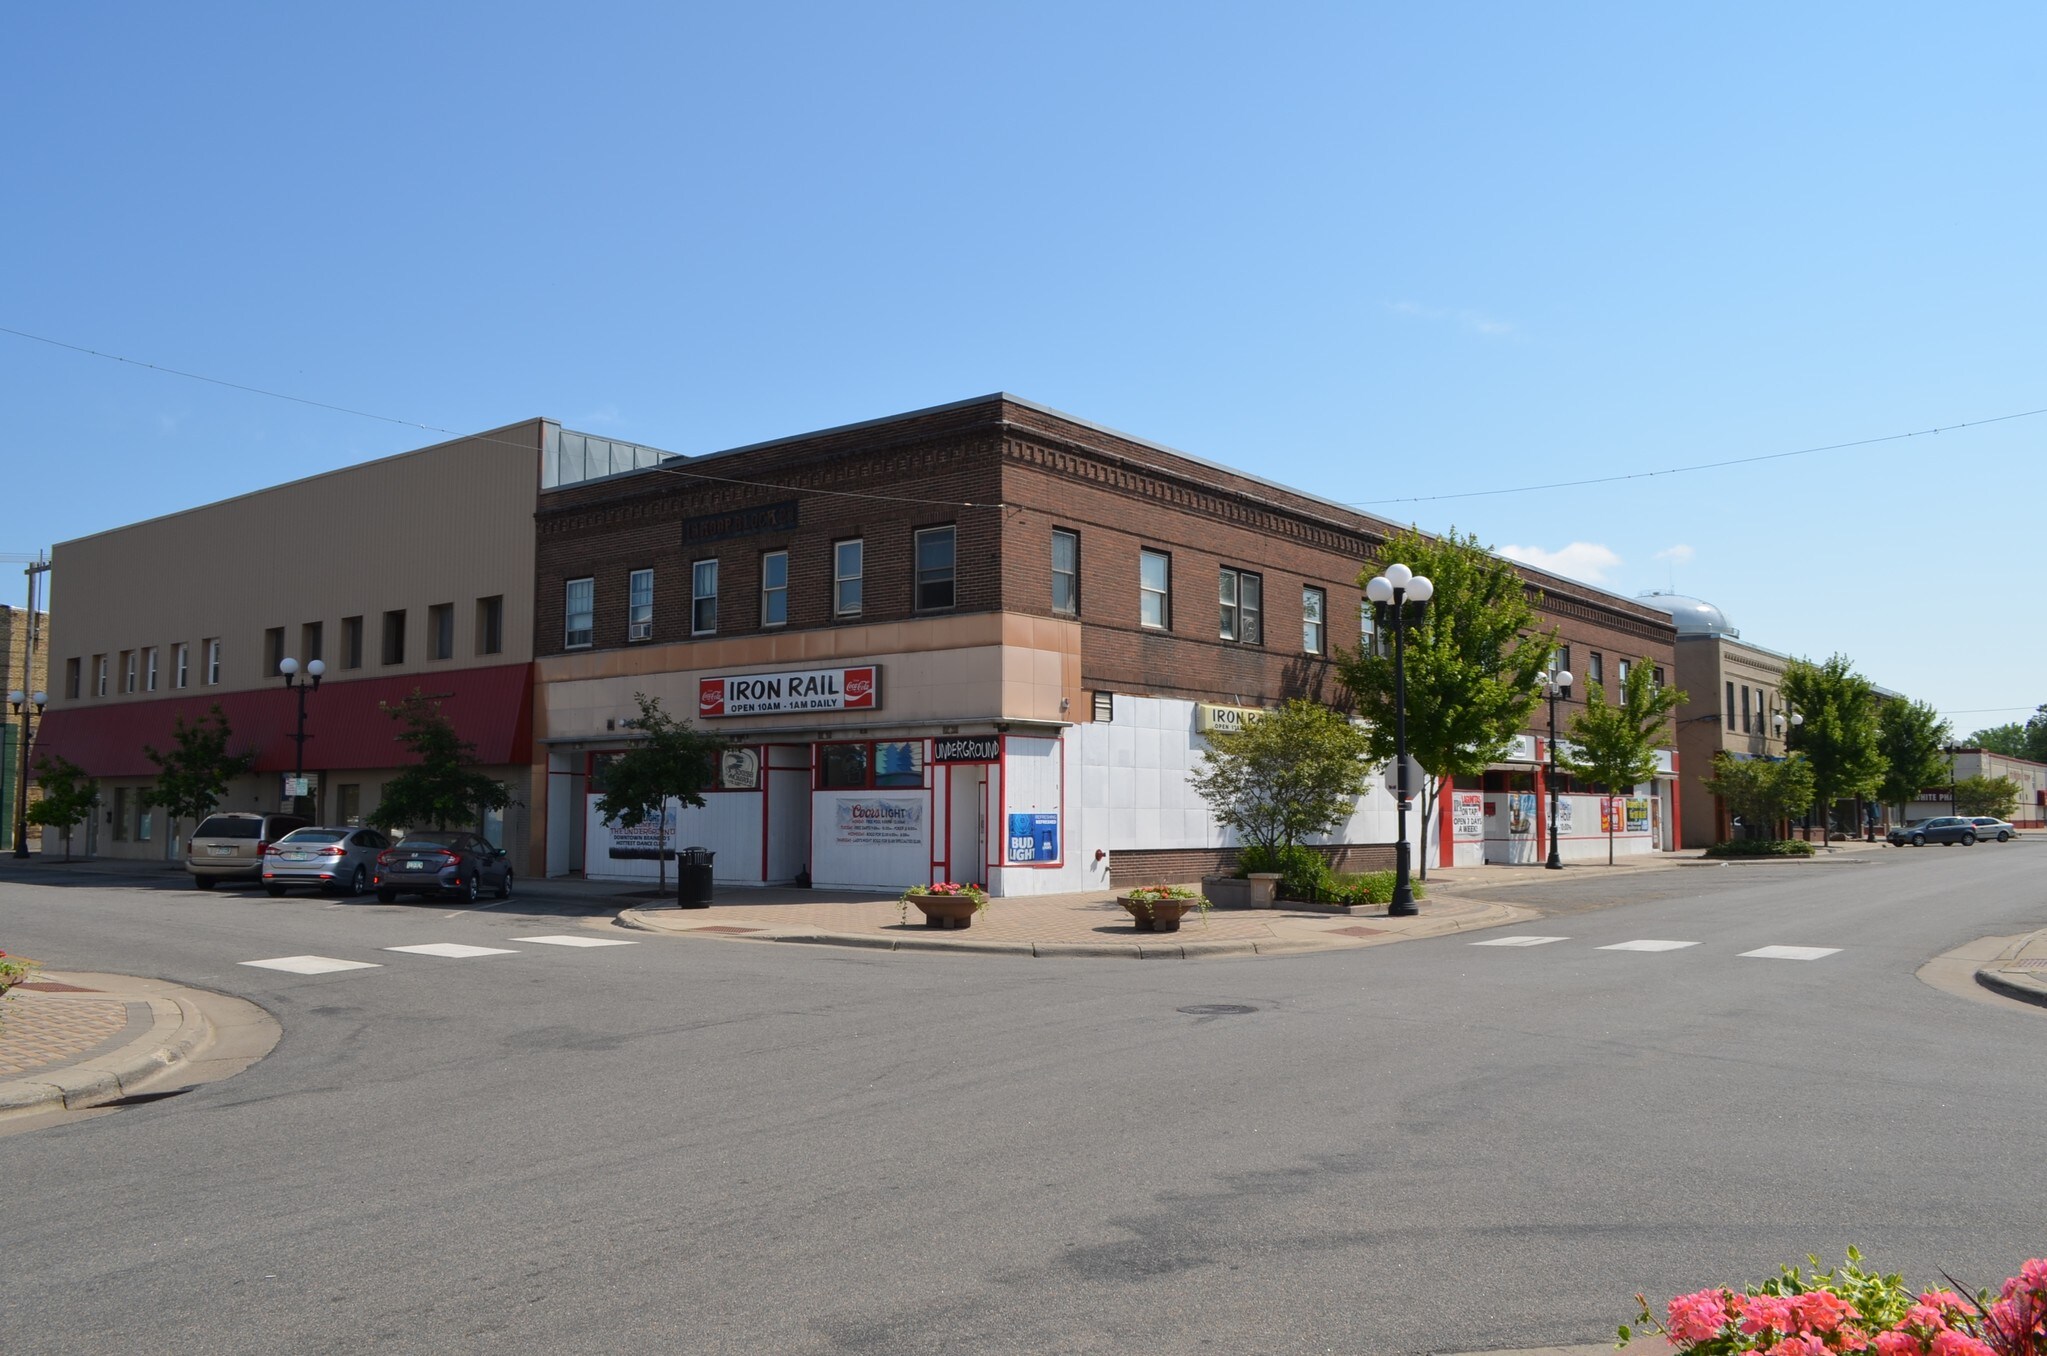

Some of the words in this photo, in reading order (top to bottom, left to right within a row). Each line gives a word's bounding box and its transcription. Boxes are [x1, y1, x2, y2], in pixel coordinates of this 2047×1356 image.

[735, 510, 777, 532] BLOCK
[730, 678, 781, 701] IRON
[788, 675, 839, 697] RAIL
[731, 703, 755, 713] OPEN
[758, 702, 780, 711] 10AM
[790, 701, 808, 710] 1AM
[810, 699, 838, 708] DAILY
[1213, 709, 1244, 724] IRON
[935, 740, 1000, 760] UNDERGROUND
[852, 804, 880, 818] Coors
[881, 808, 906, 818] LIGHT
[1453, 817, 1466, 825] OPEN
[1011, 837, 1034, 849] BUD
[1009, 847, 1036, 861] LIGHT
